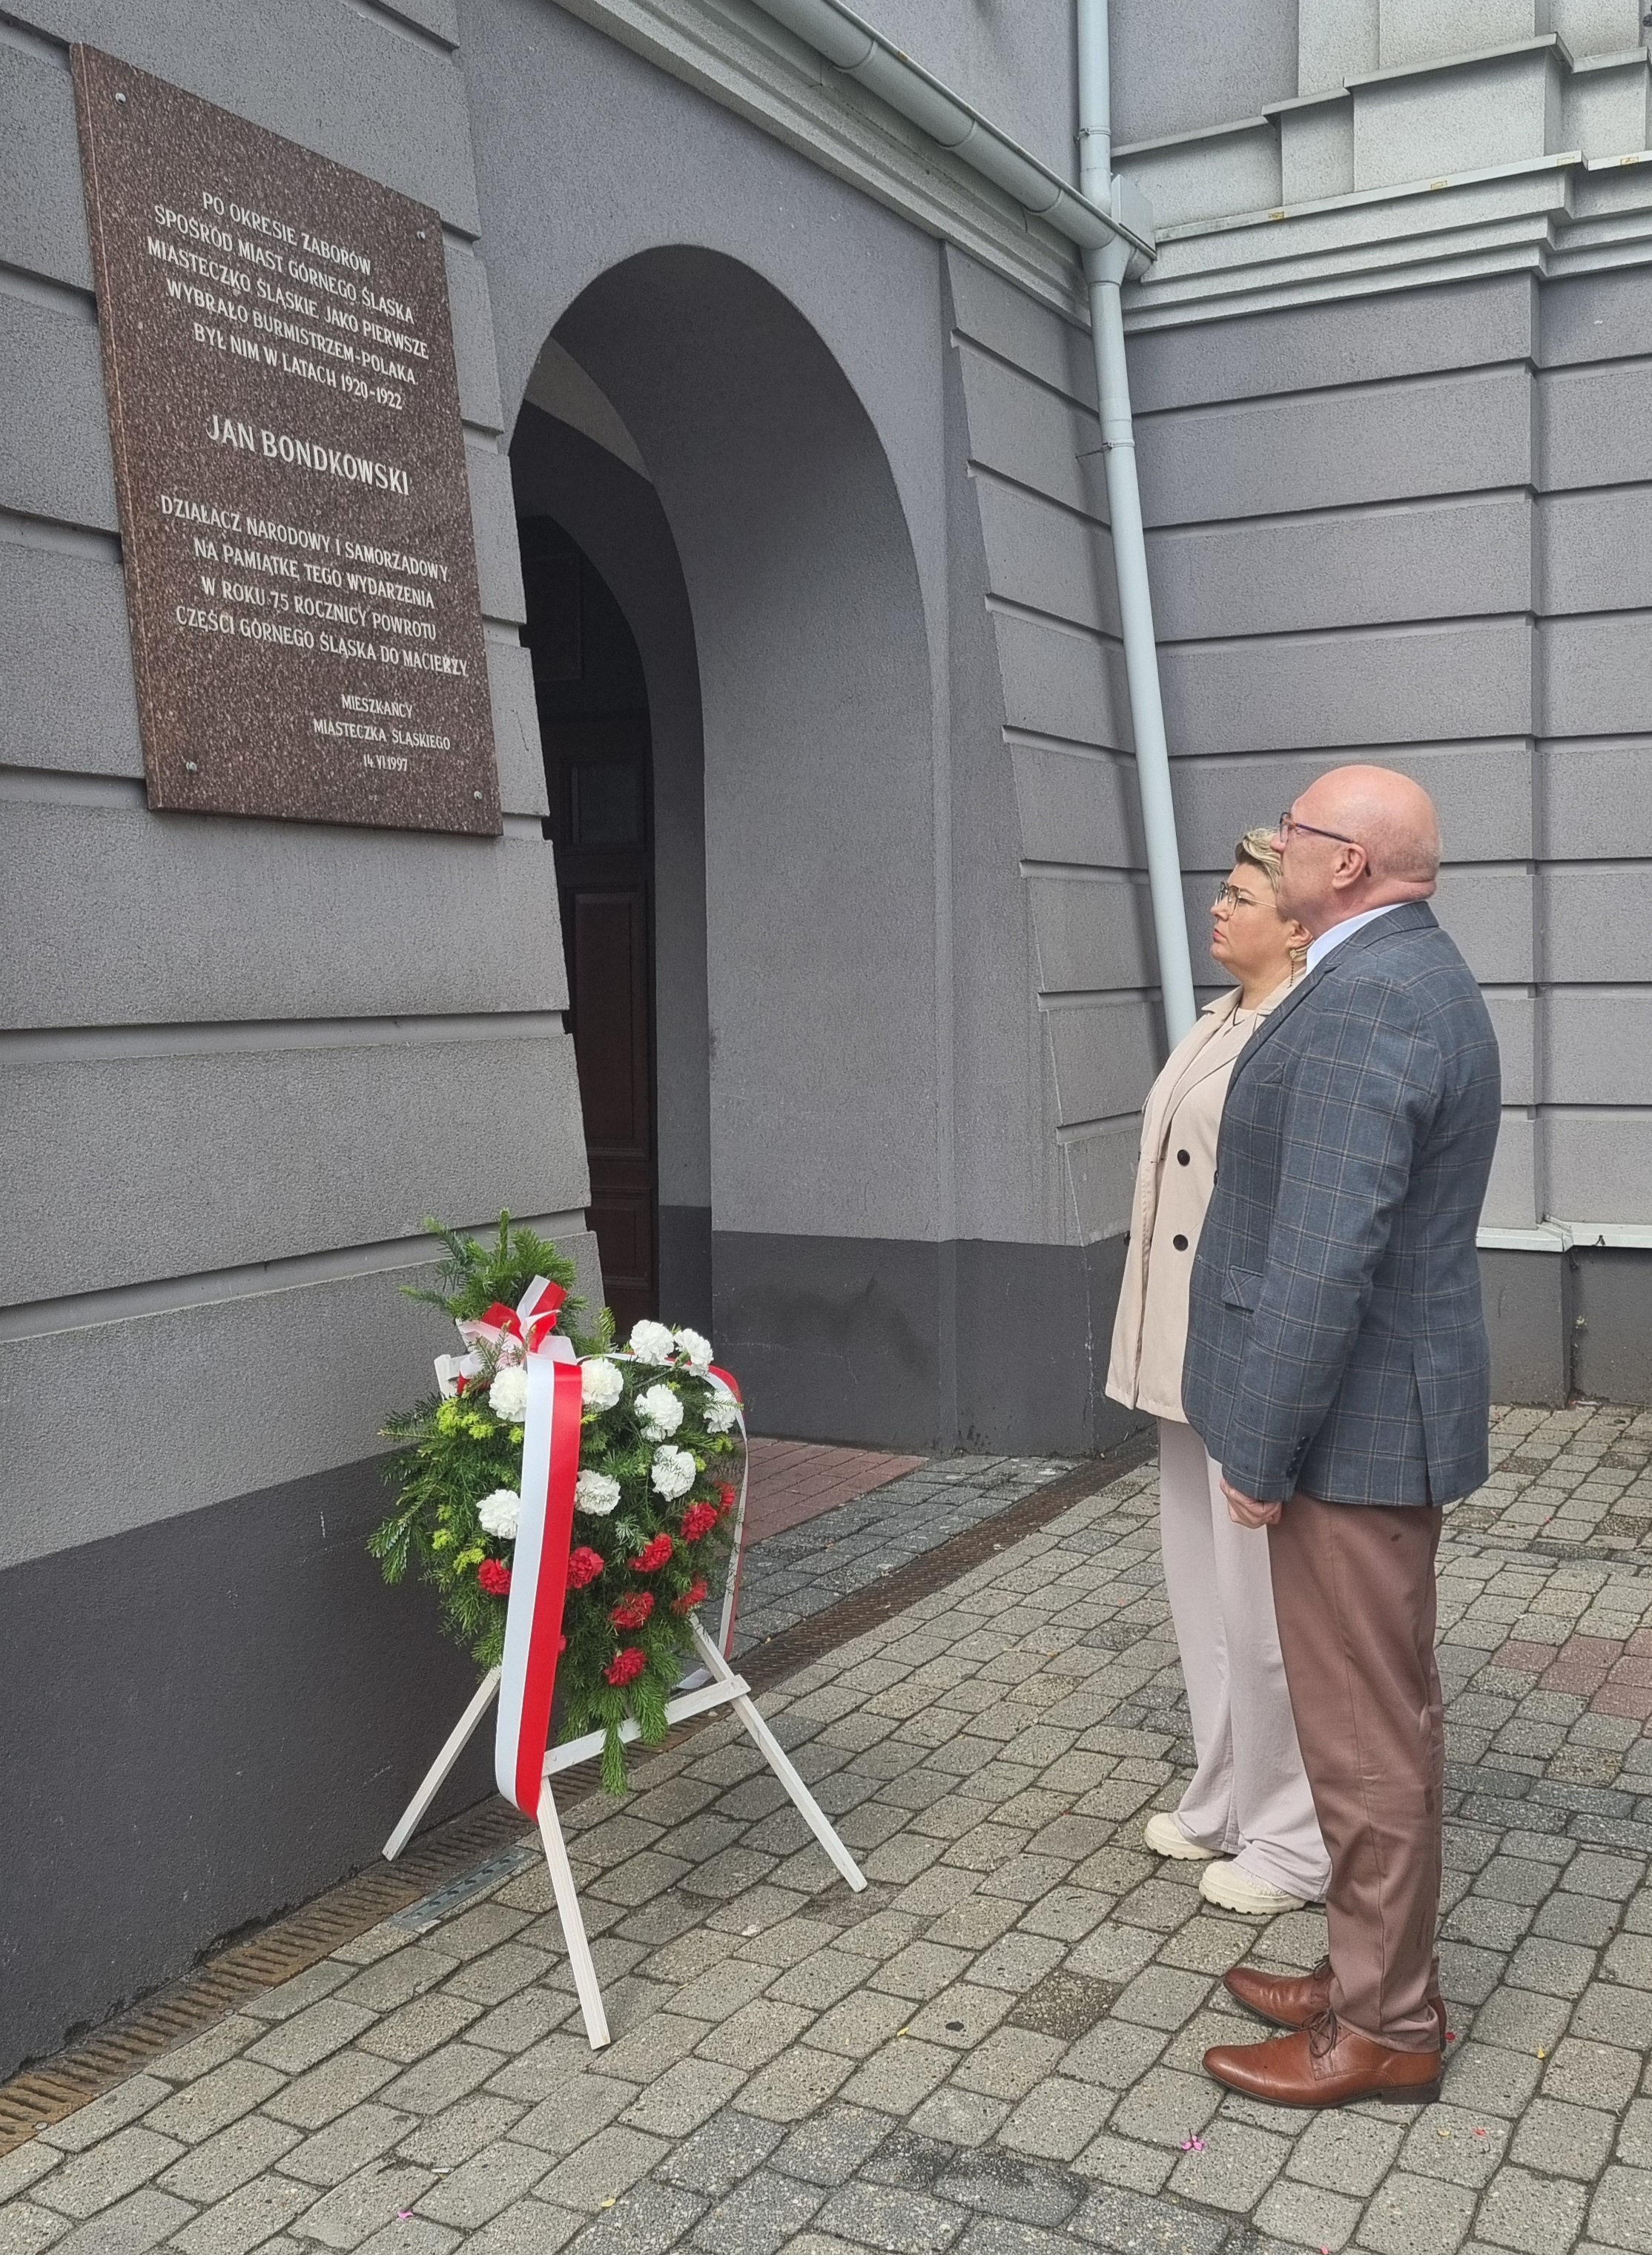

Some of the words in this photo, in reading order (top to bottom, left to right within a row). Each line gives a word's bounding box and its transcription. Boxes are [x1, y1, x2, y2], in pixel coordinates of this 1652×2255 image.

[154, 205, 233, 252] SPOŚRÓD
[238, 239, 283, 273] MIAST
[288, 260, 357, 302] GÓRNEGO
[362, 286, 415, 325] ŚLĄSKA
[202, 192, 225, 216] PO
[230, 203, 297, 246] OKRESIE
[301, 233, 371, 276] ZABORÓW
[147, 236, 251, 292] MIASTECZKO
[257, 278, 319, 320] ŚLĄSKIE
[323, 306, 359, 333] JAKO
[362, 320, 429, 360] PIERWSZE
[165, 278, 248, 323] WYBRAŁO
[194, 323, 227, 351] BYŁ
[230, 334, 260, 362] NIM
[263, 346, 277, 367] W
[283, 352, 337, 388] LATACH
[340, 374, 403, 410] 1920-1922
[206, 415, 256, 452] JAN
[261, 429, 410, 495] BONDKOWSKI
[161, 495, 242, 532] DZIAŁACZ
[246, 517, 330, 553] NARODOWY
[335, 538, 341, 556] I
[345, 541, 449, 582] SAMORZĄDOWY
[194, 538, 219, 561] NA
[222, 544, 300, 581] PAMIĄTKĘ
[303, 563, 343, 588] TEGO
[346, 572, 435, 609] WYDARZENIA
[176, 606, 236, 635] CZĘŚCI
[239, 618, 314, 650] GÓRNEGO
[319, 631, 377, 661] ŚLĄSKA
[380, 645, 400, 665] DO
[201, 575, 216, 596] W
[222, 581, 265, 607] ROKU
[270, 591, 289, 611] 75
[294, 595, 367, 627] ROCZNICY
[371, 612, 437, 641] POWROTU
[313, 719, 387, 742] MIASTECZKA
[391, 728, 451, 750] ŚLĄSKIEGO
[340, 694, 413, 719] MIESZKAŃCY
